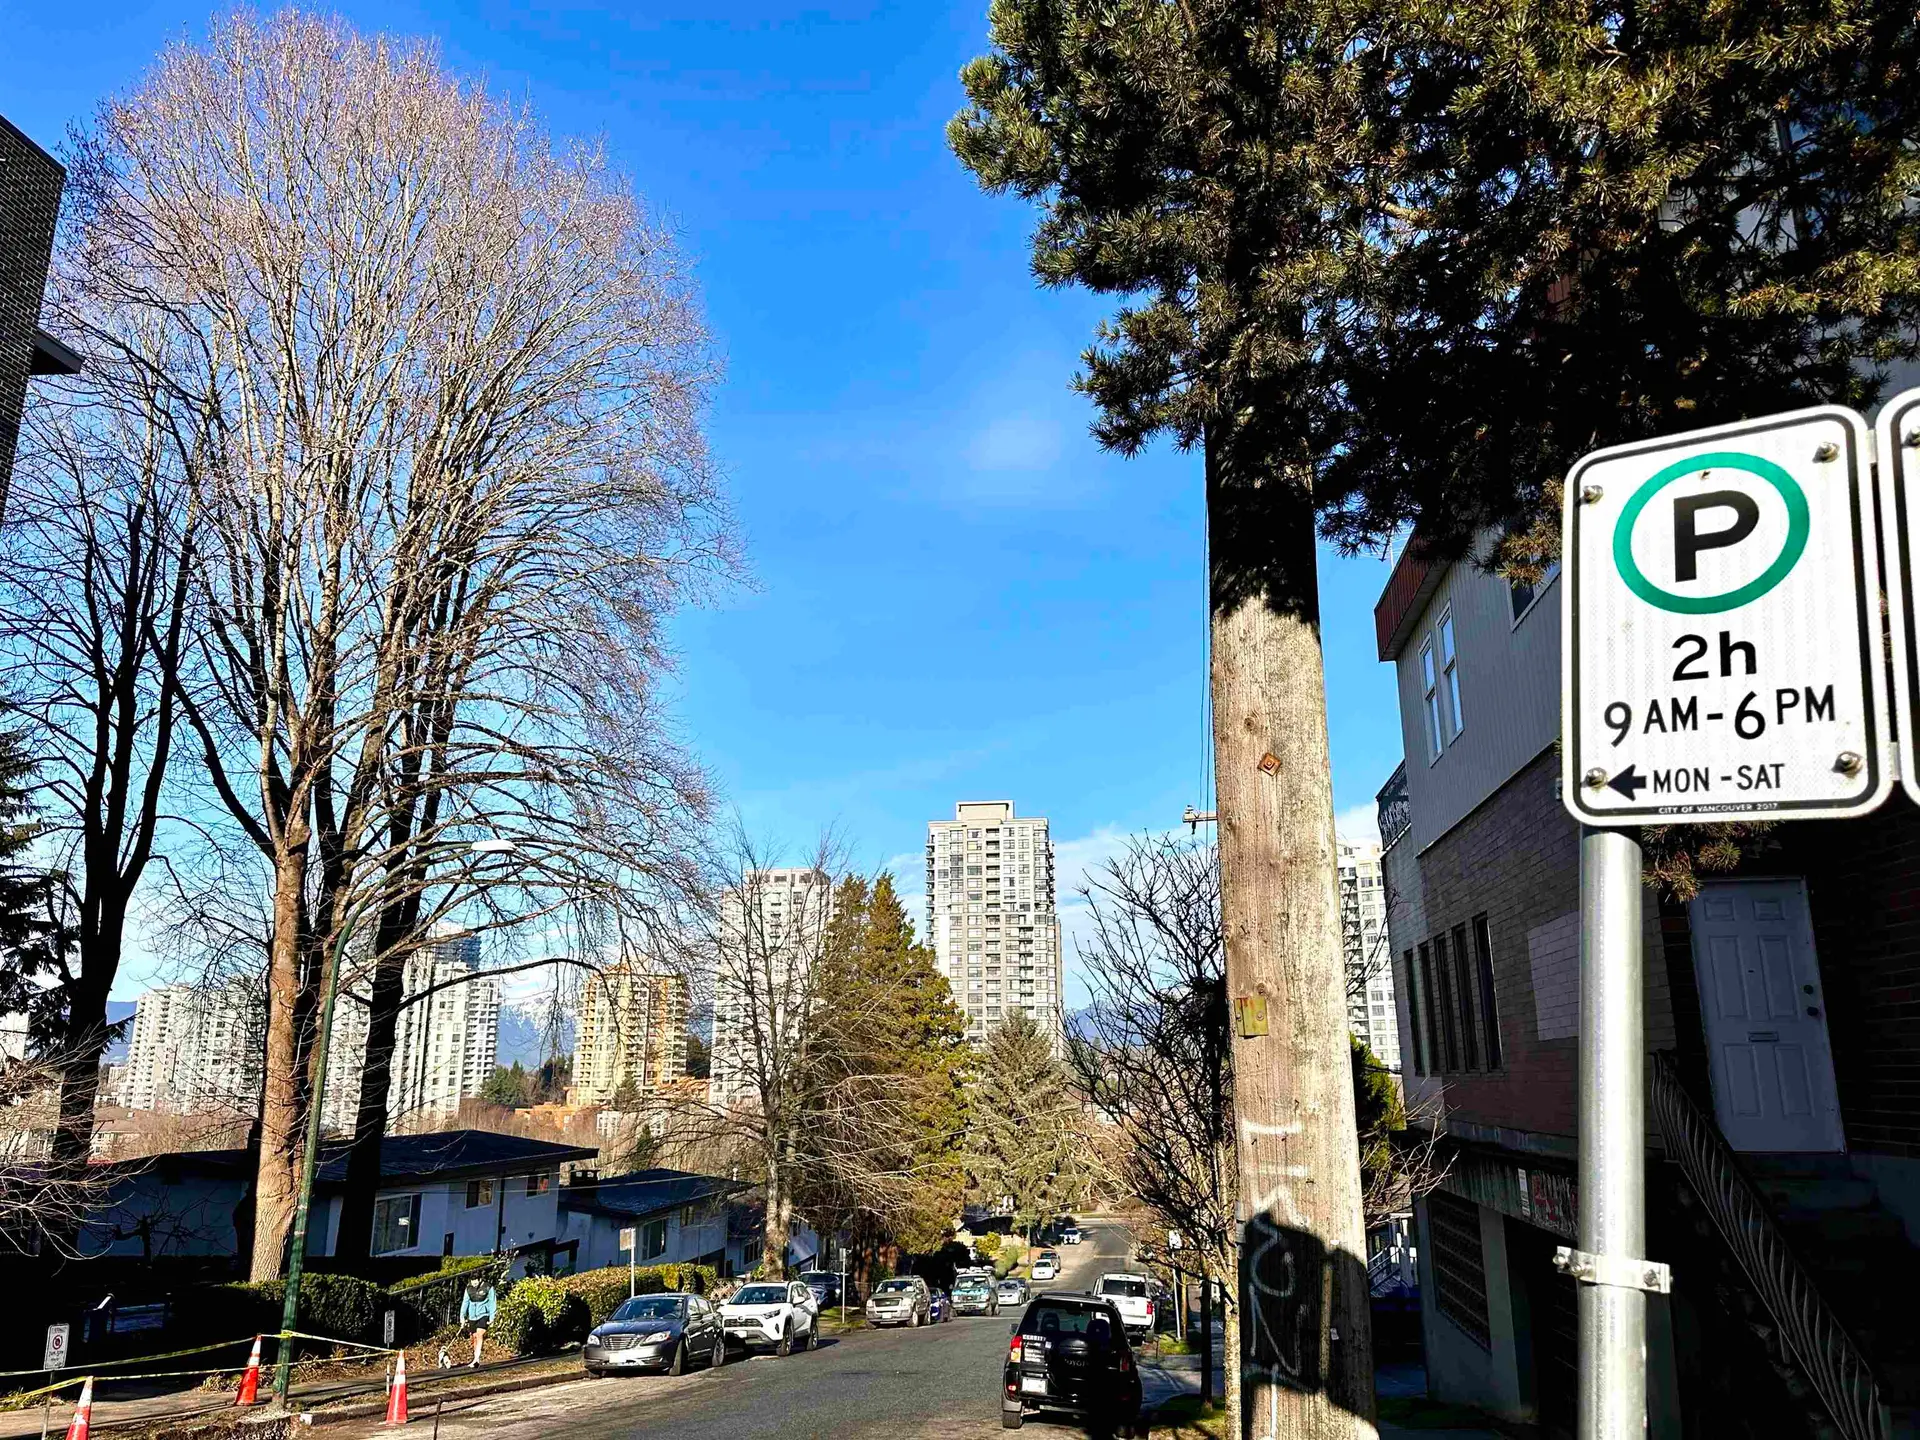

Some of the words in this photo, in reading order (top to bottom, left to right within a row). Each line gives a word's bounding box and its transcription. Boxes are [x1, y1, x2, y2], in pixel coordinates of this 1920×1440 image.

[1674, 491, 1760, 583] P
[1672, 631, 1757, 682] 2h
[1653, 768, 1710, 794] MON
[1658, 806, 1678, 814] CITY
[1681, 805, 1694, 814] OF
[1696, 803, 1752, 813] VANCOUVER
[1756, 802, 1778, 811] 2017
